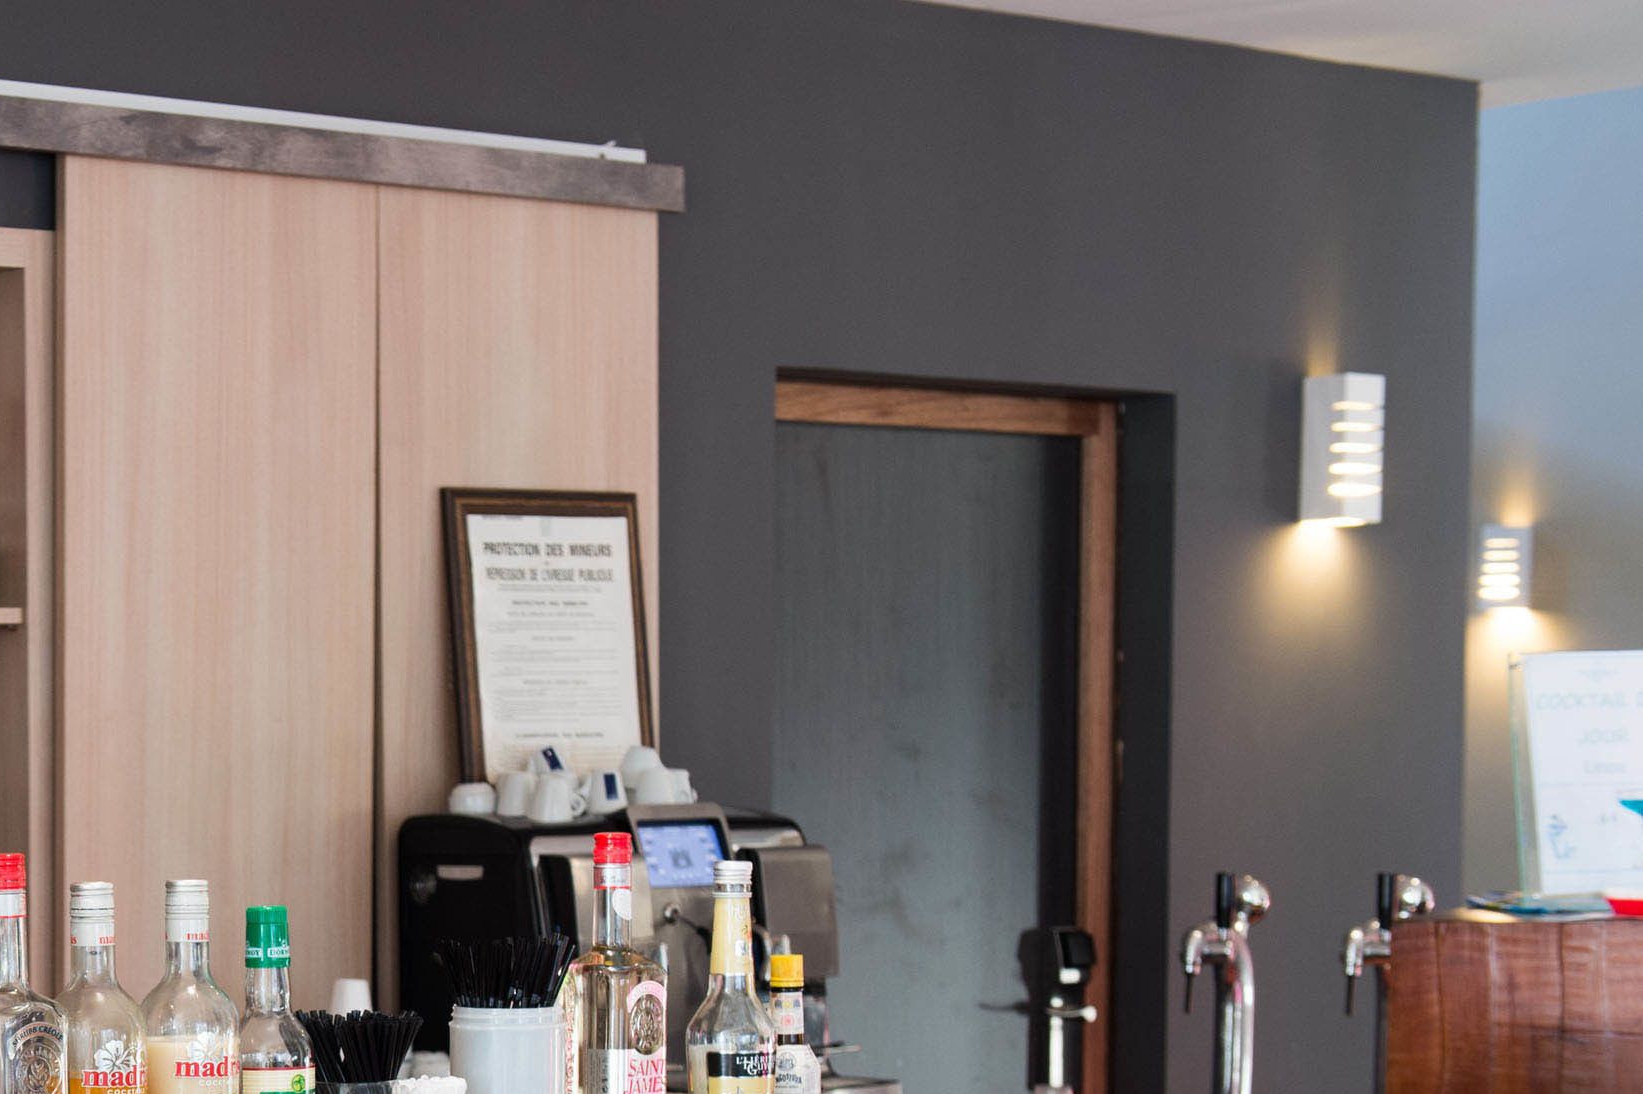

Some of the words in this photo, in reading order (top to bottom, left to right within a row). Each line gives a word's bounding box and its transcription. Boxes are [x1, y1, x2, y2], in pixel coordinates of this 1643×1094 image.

[483, 542, 540, 557] PROTECTION
[545, 543, 564, 557] DES
[568, 543, 612, 558] MINEURS
[82, 1065, 147, 1088] madr
[174, 1056, 240, 1078] madr
[628, 1058, 665, 1077] SAINT
